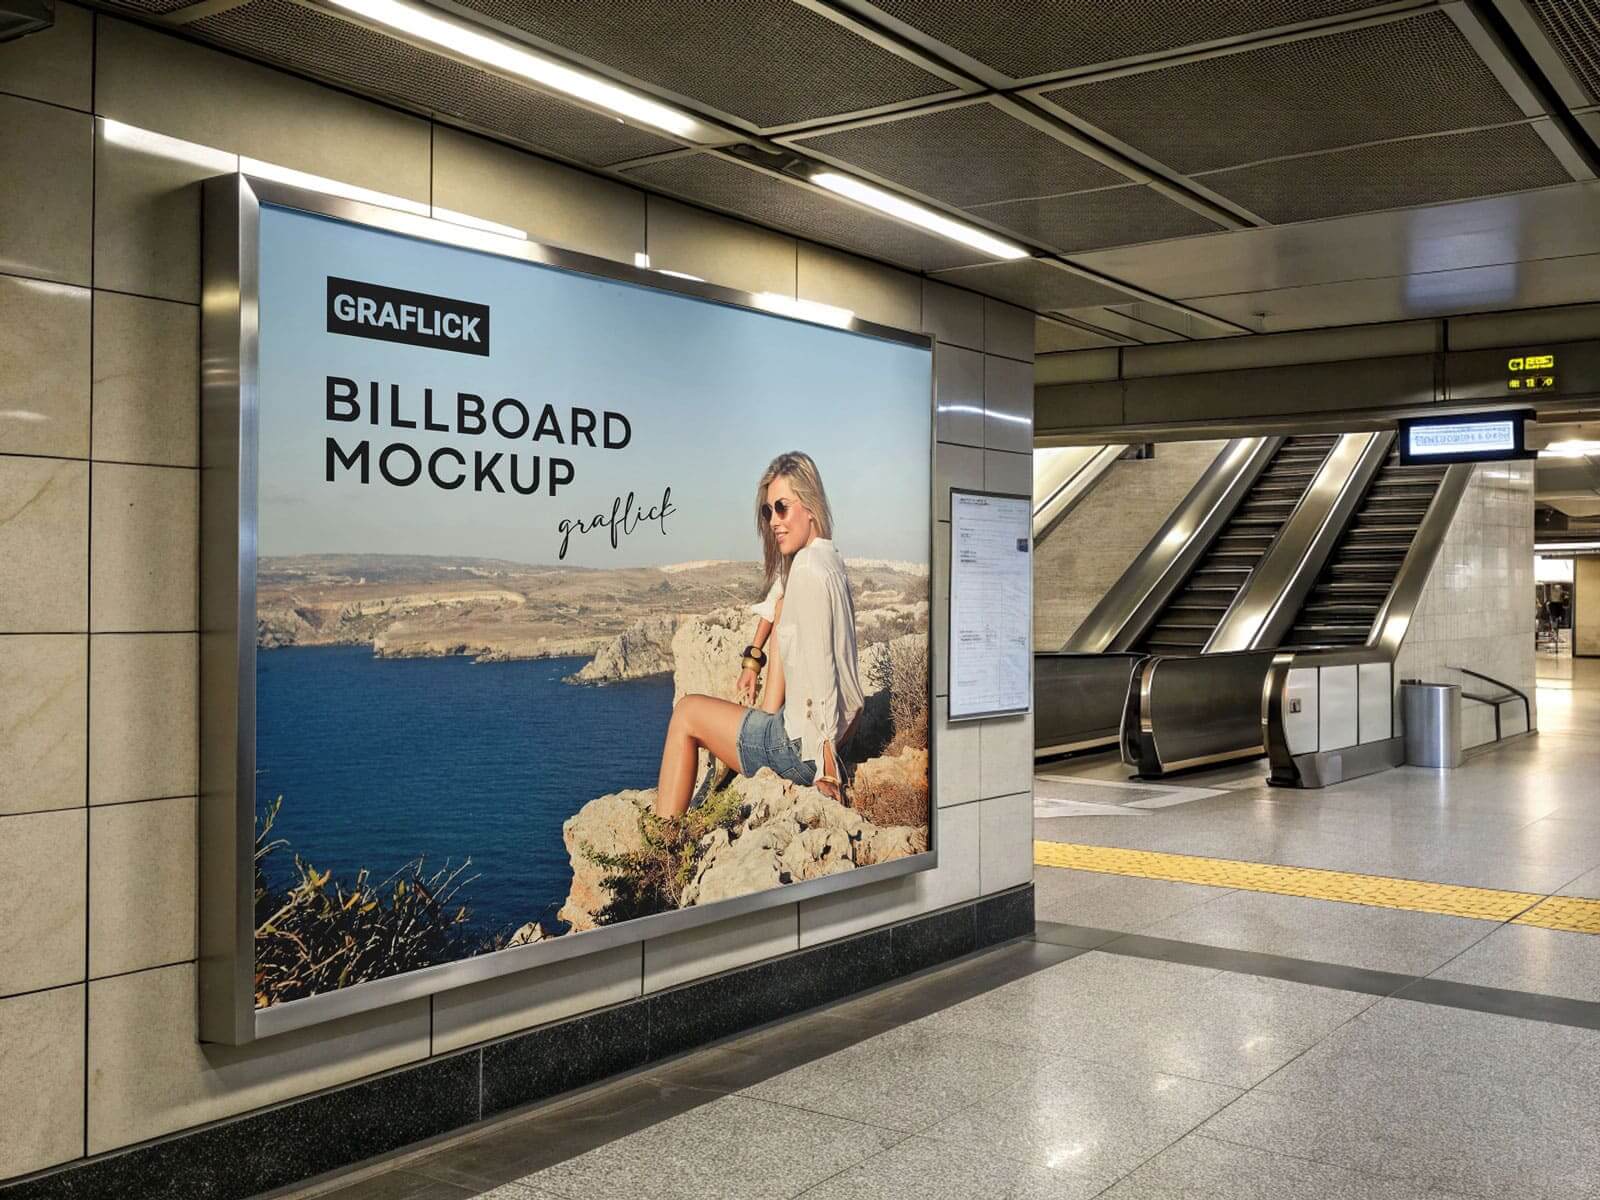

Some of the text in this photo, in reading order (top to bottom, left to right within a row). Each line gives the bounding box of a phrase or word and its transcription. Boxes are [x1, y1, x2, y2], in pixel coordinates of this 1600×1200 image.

[333, 293, 481, 343] GRAFLICK
[326, 375, 632, 450] BILLBOARD
[325, 437, 575, 497] MOCKUP
[558, 486, 677, 560] graflick
